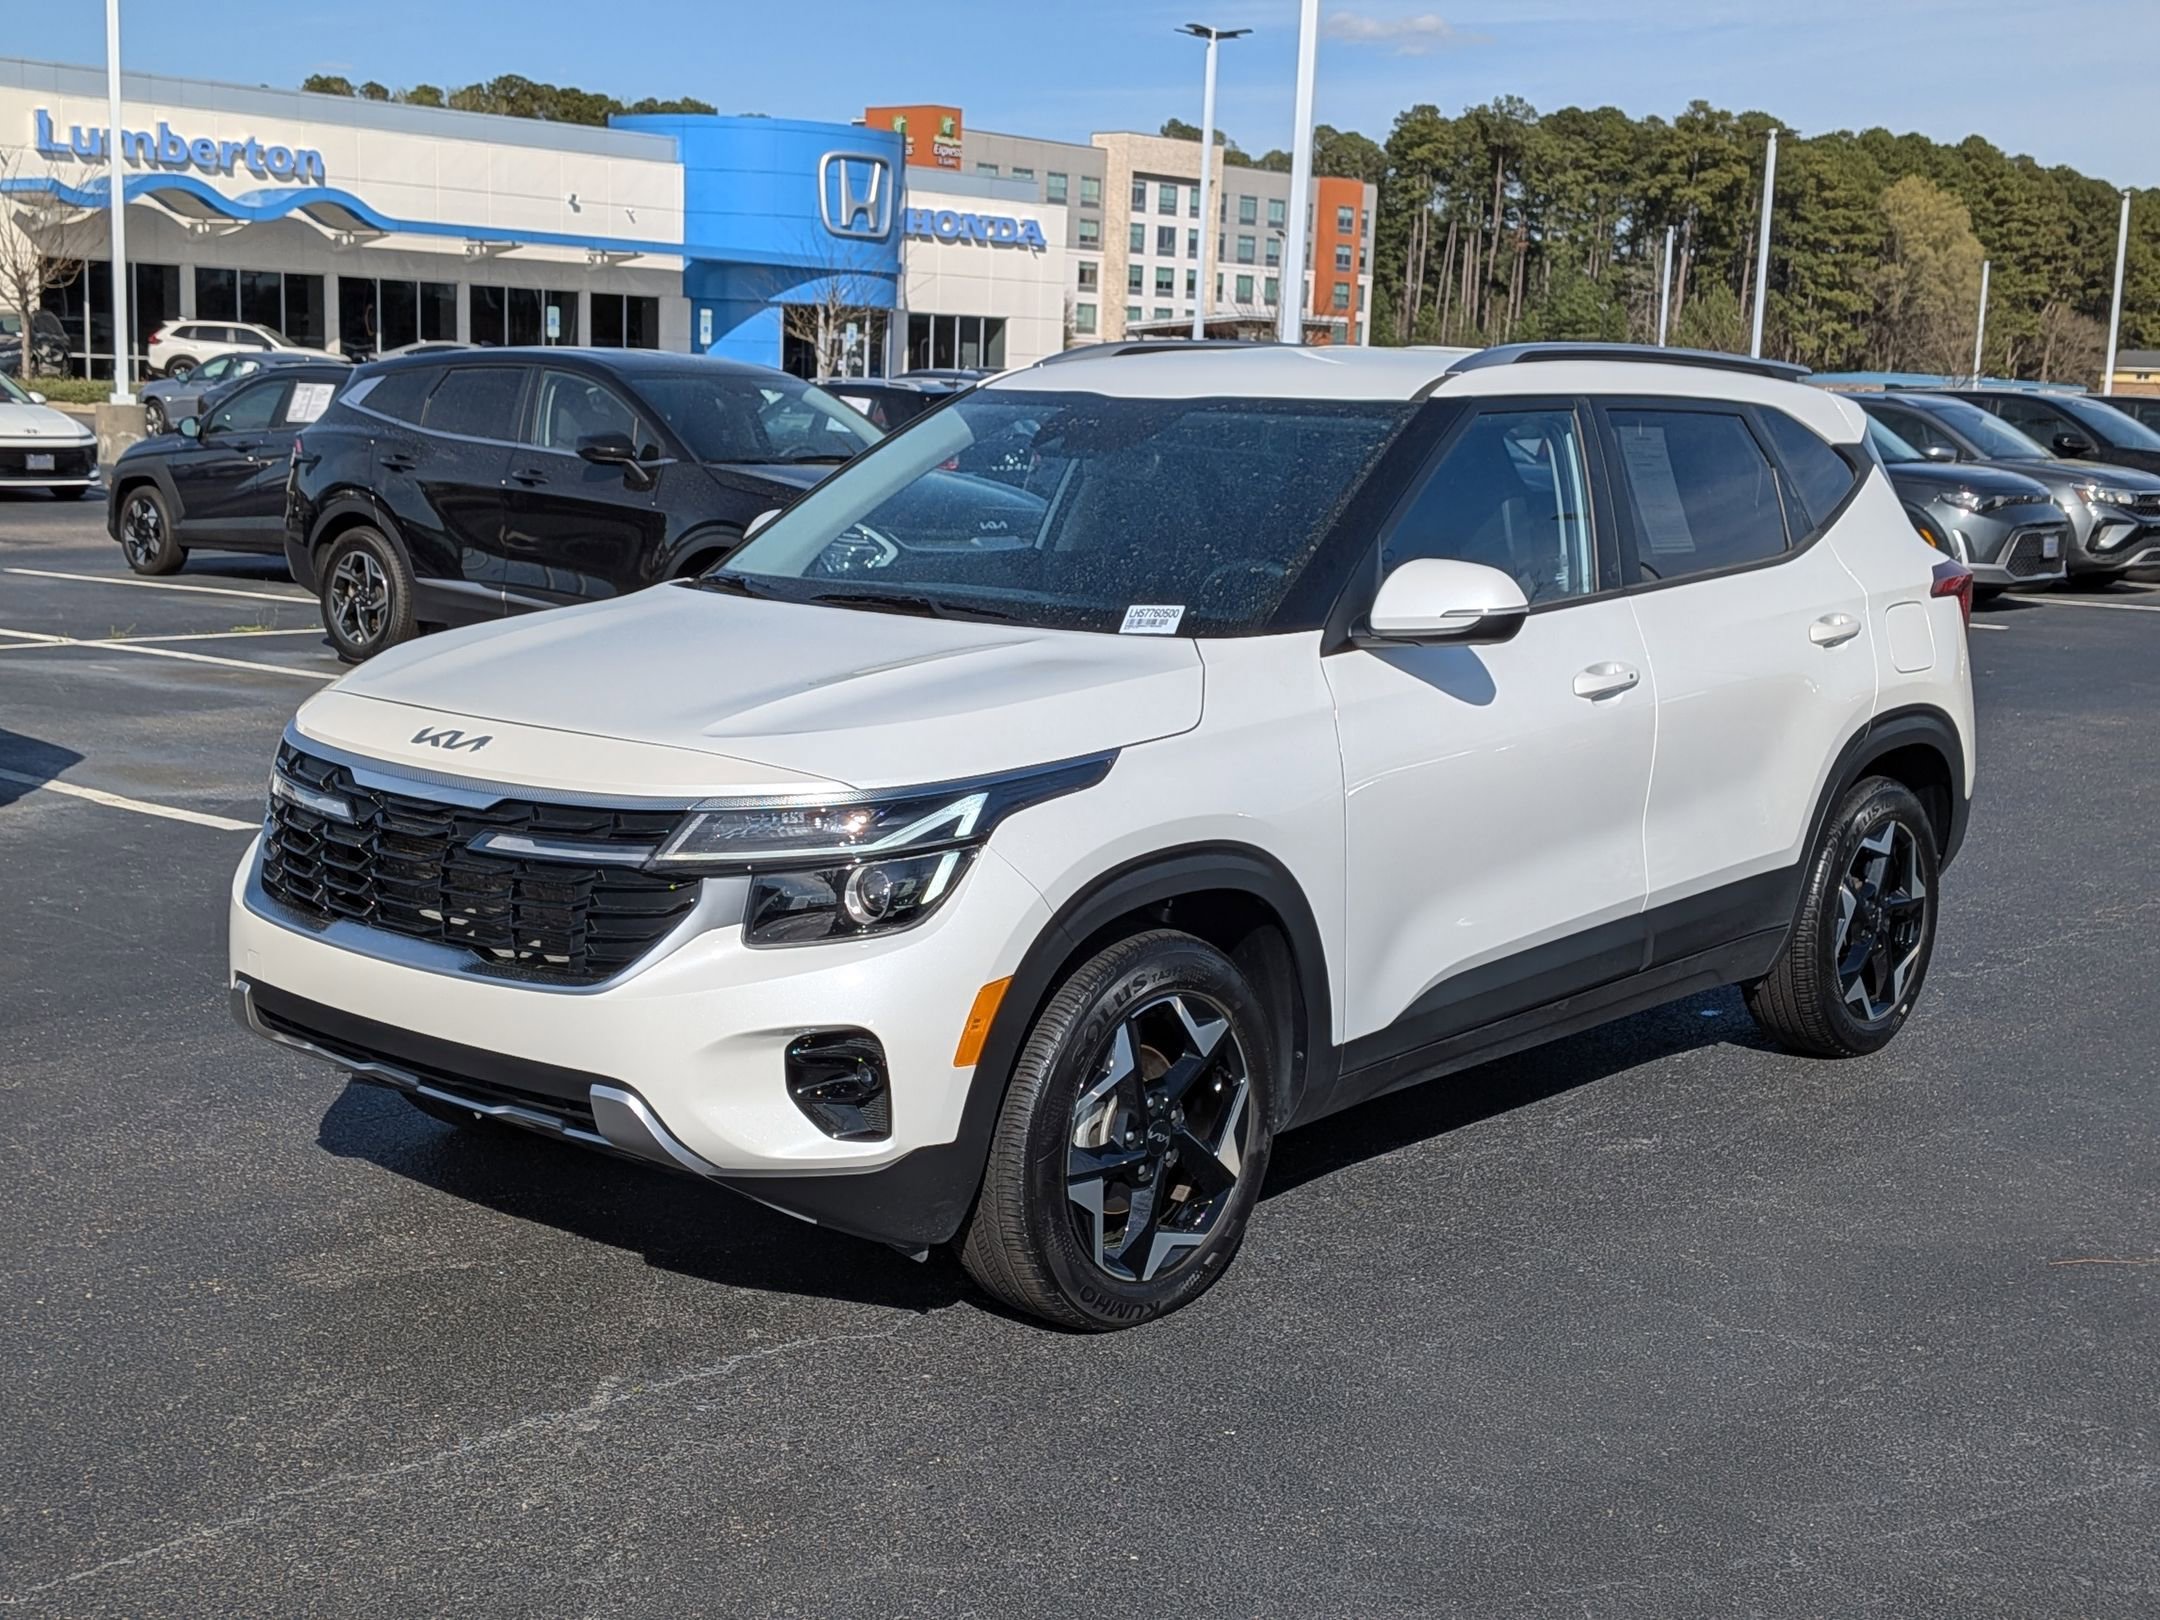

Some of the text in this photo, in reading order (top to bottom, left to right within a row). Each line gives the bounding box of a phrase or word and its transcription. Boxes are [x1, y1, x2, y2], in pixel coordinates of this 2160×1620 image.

[34, 109, 324, 178] Lumberton
[904, 208, 1047, 247] HONDA
[410, 726, 493, 753] KIA
[1080, 1285, 1161, 1319] KUMHO
